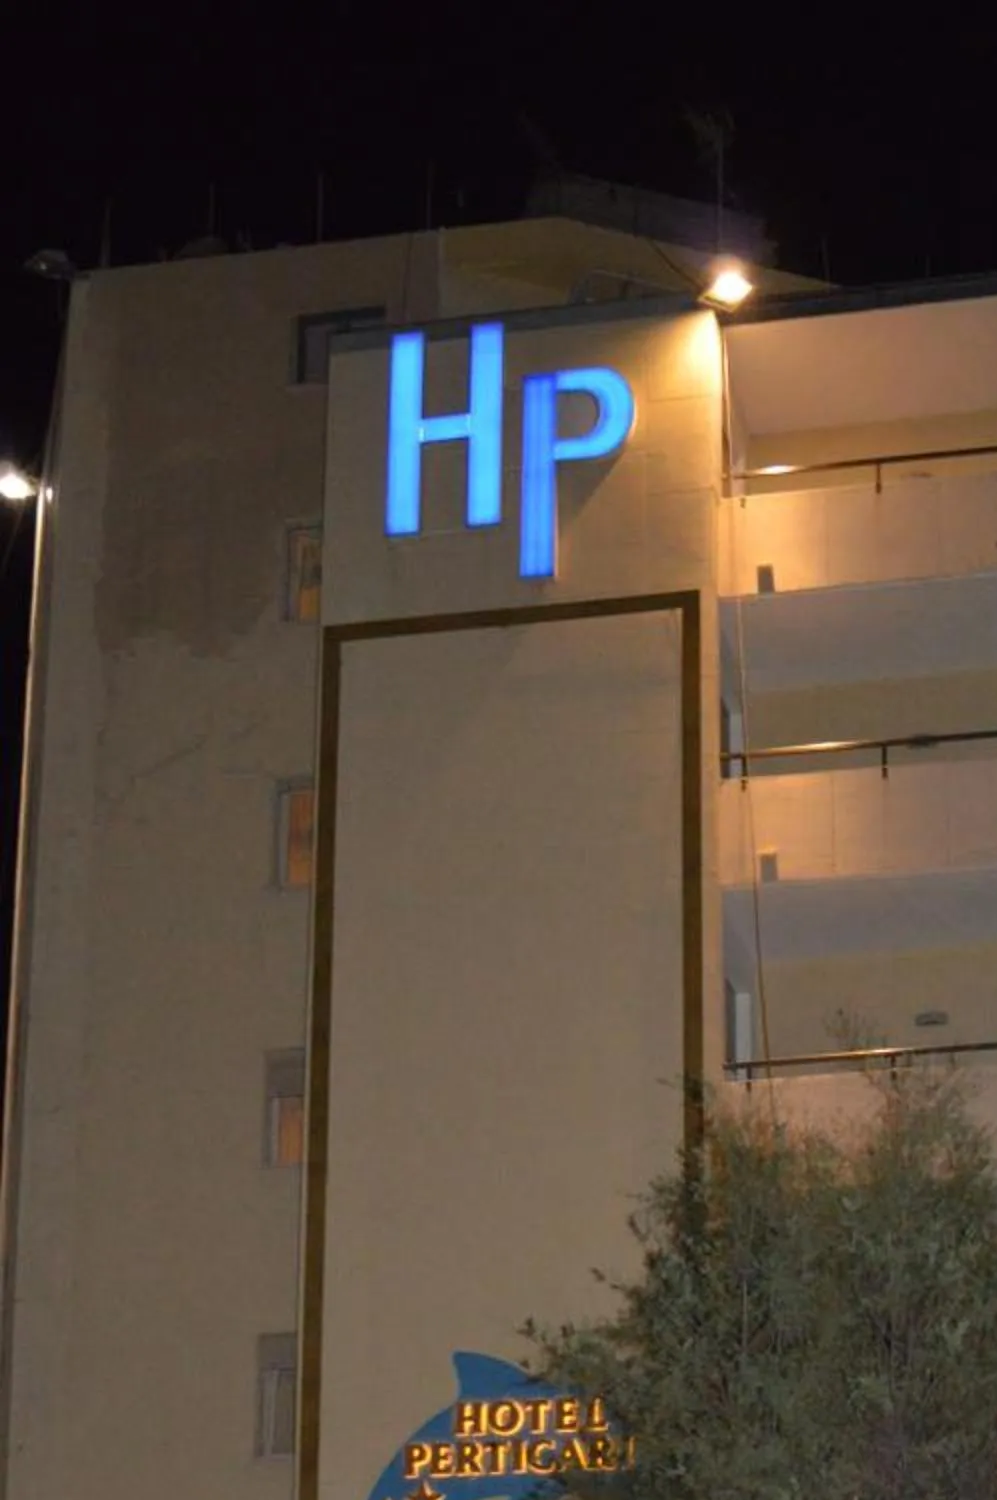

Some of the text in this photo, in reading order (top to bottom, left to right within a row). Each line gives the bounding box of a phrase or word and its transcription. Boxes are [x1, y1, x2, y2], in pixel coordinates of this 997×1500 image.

[384, 320, 636, 579] HP
[454, 1397, 610, 1437] HOTEL
[404, 1436, 637, 1479] PERTICARI
